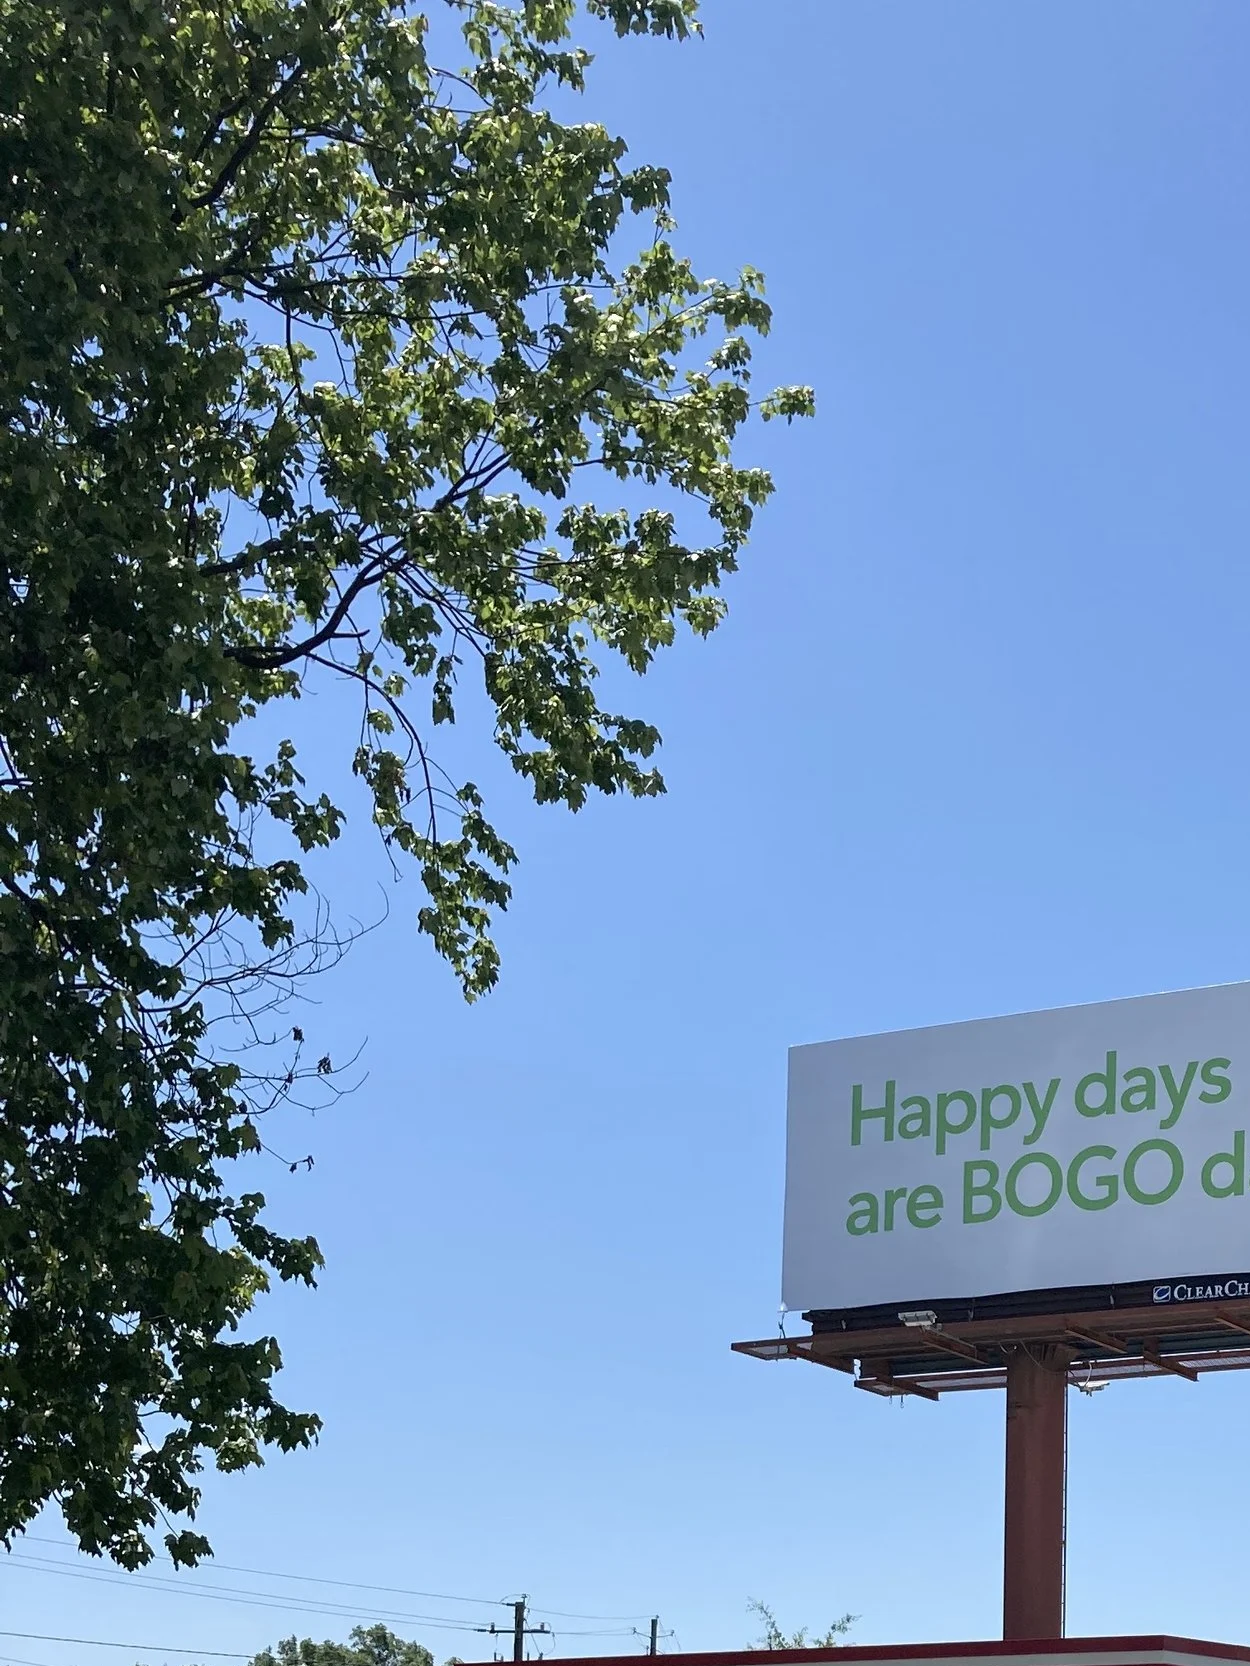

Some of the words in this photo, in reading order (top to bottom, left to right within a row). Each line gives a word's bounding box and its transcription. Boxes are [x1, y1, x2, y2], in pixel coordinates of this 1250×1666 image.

[851, 1080, 1061, 1155] Happy
[1074, 1051, 1232, 1130] days
[846, 1184, 944, 1236] are
[963, 1138, 1184, 1225] BOGO
